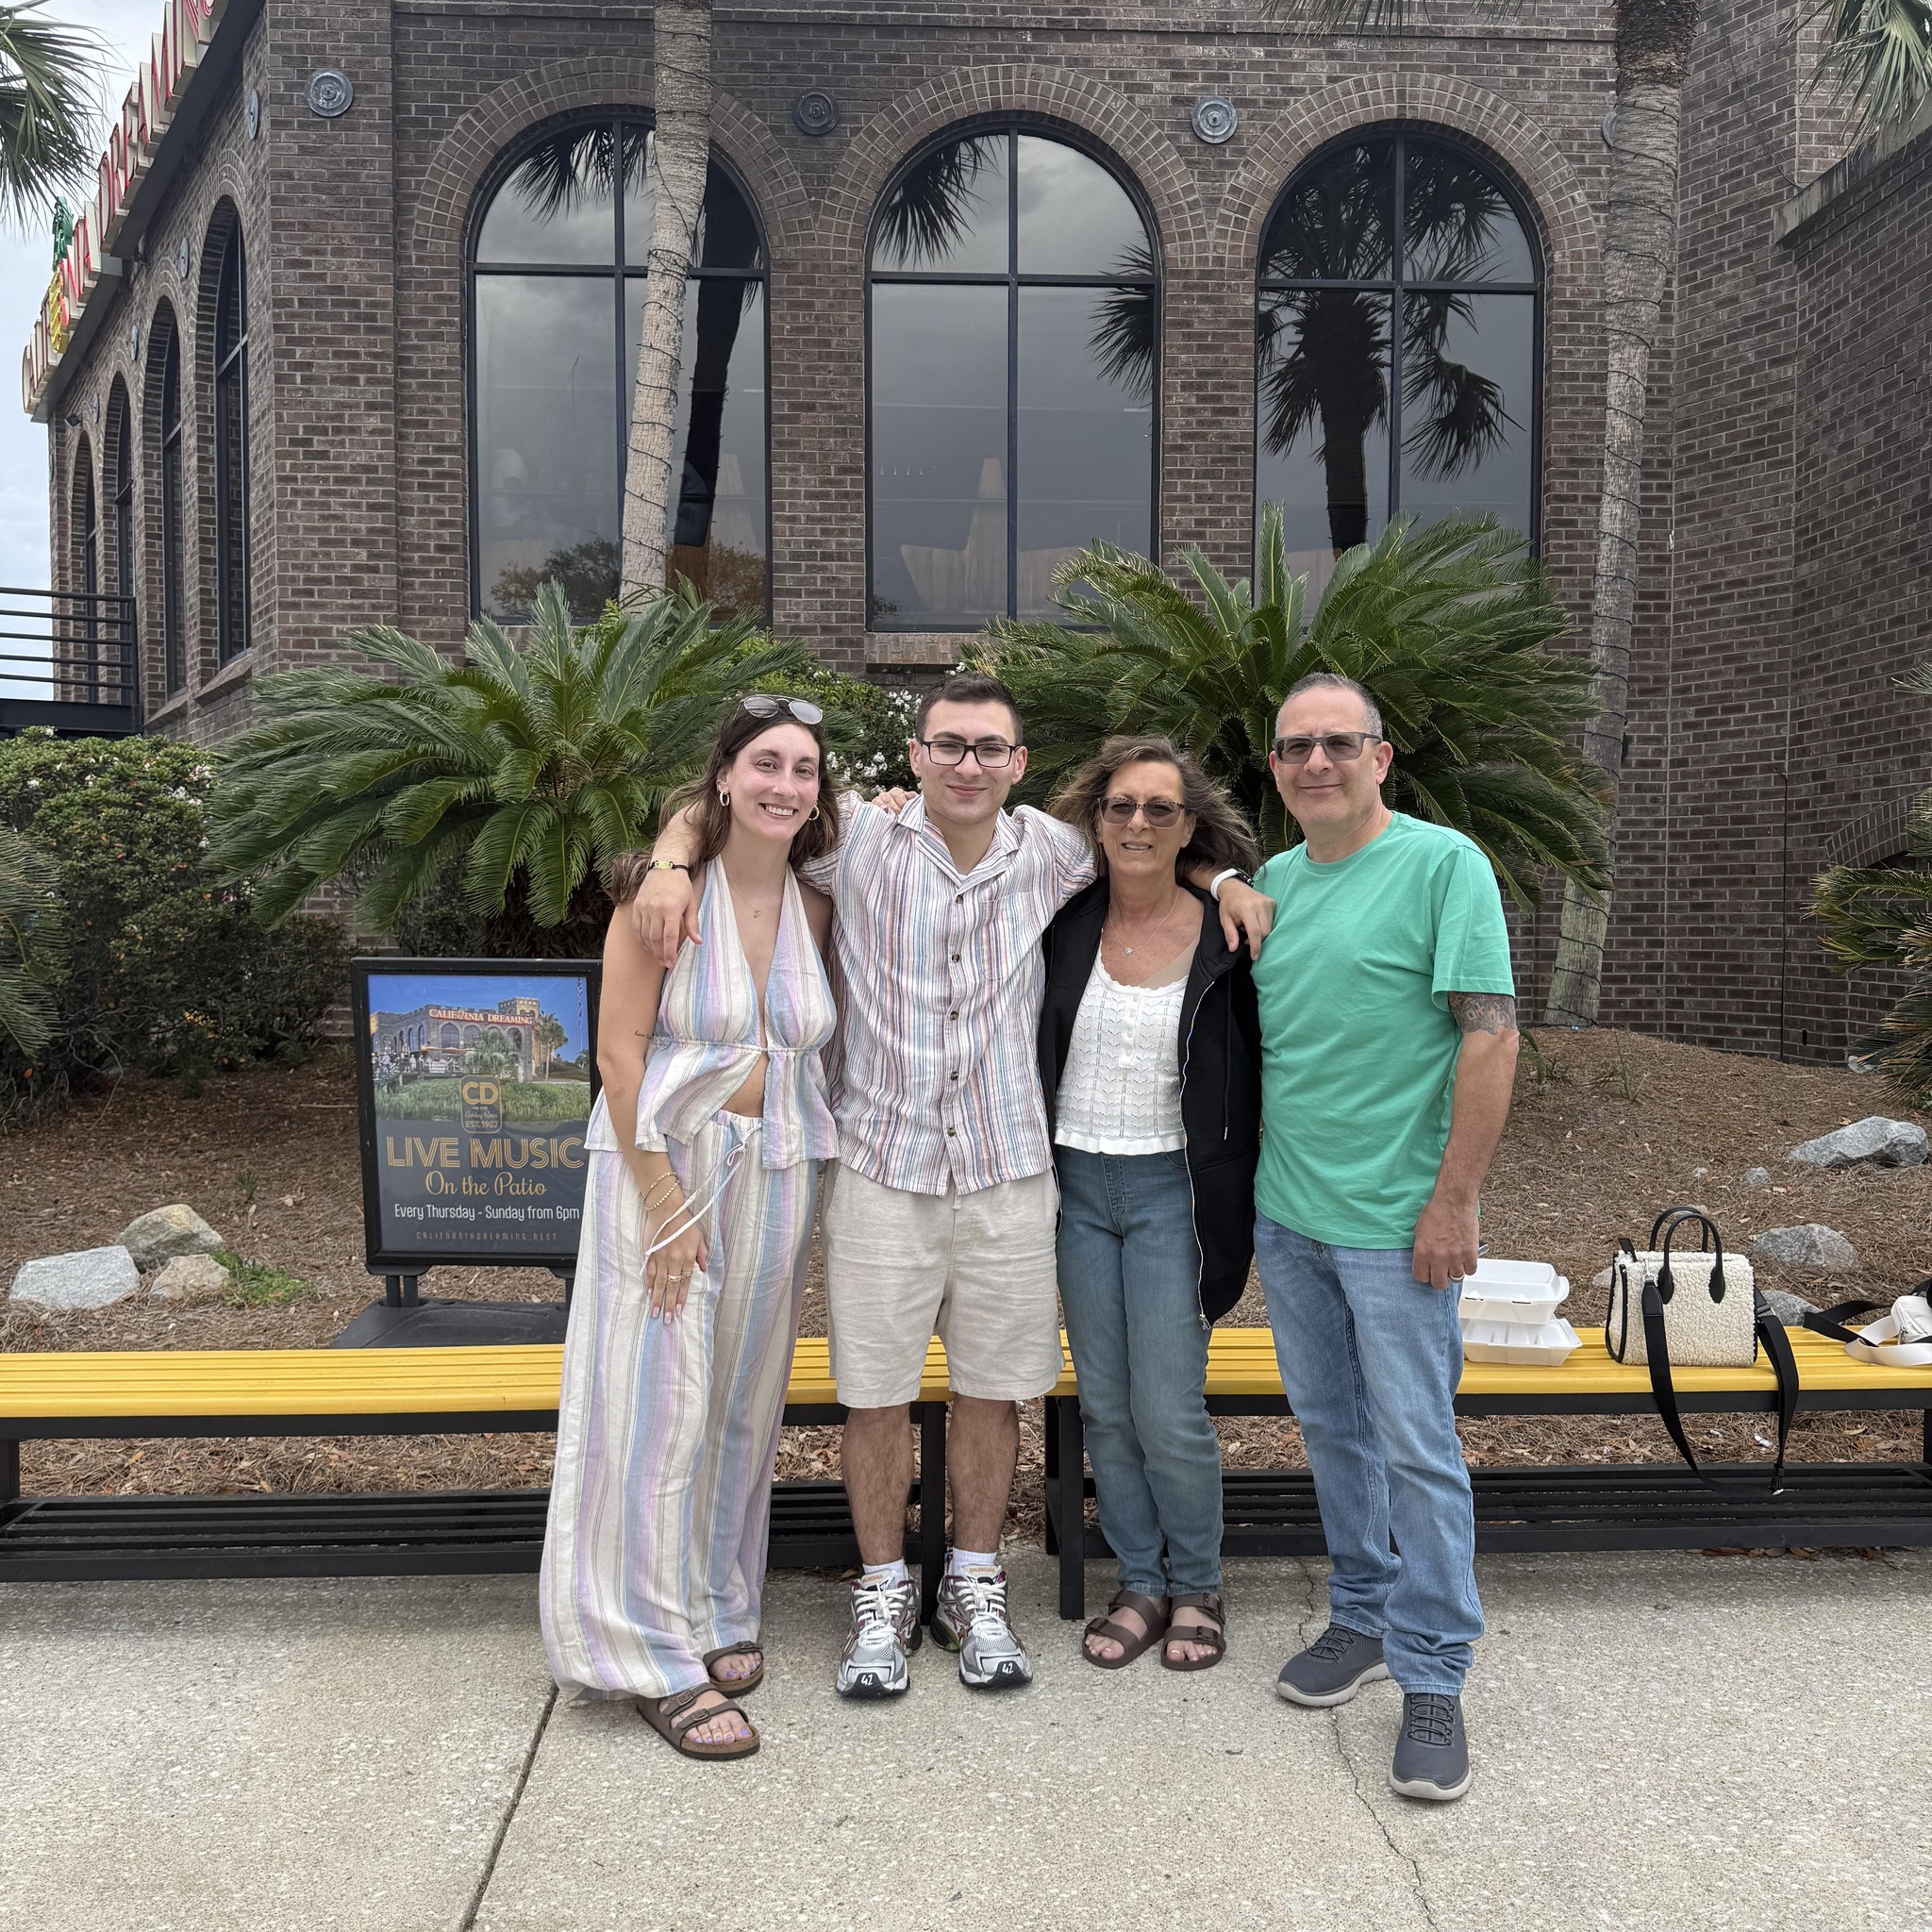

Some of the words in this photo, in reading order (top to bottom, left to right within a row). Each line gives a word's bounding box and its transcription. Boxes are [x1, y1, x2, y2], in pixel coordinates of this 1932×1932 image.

[487, 1013, 532, 1024] DREAMING
[462, 1081, 499, 1105] CD
[387, 1136, 461, 1168] LIVE
[470, 1137, 585, 1169] MUSIC
[425, 1170, 458, 1195] On
[461, 1175, 490, 1196] the
[494, 1171, 547, 1196] Patio
[394, 1204, 424, 1220] Every
[425, 1204, 475, 1221] Thursday
[485, 1206, 525, 1221] Sunday
[526, 1206, 554, 1219] from
[556, 1206, 580, 1221] 6pm
[1002, 1662, 1014, 1674] 42
[860, 1674, 874, 1686] 42
